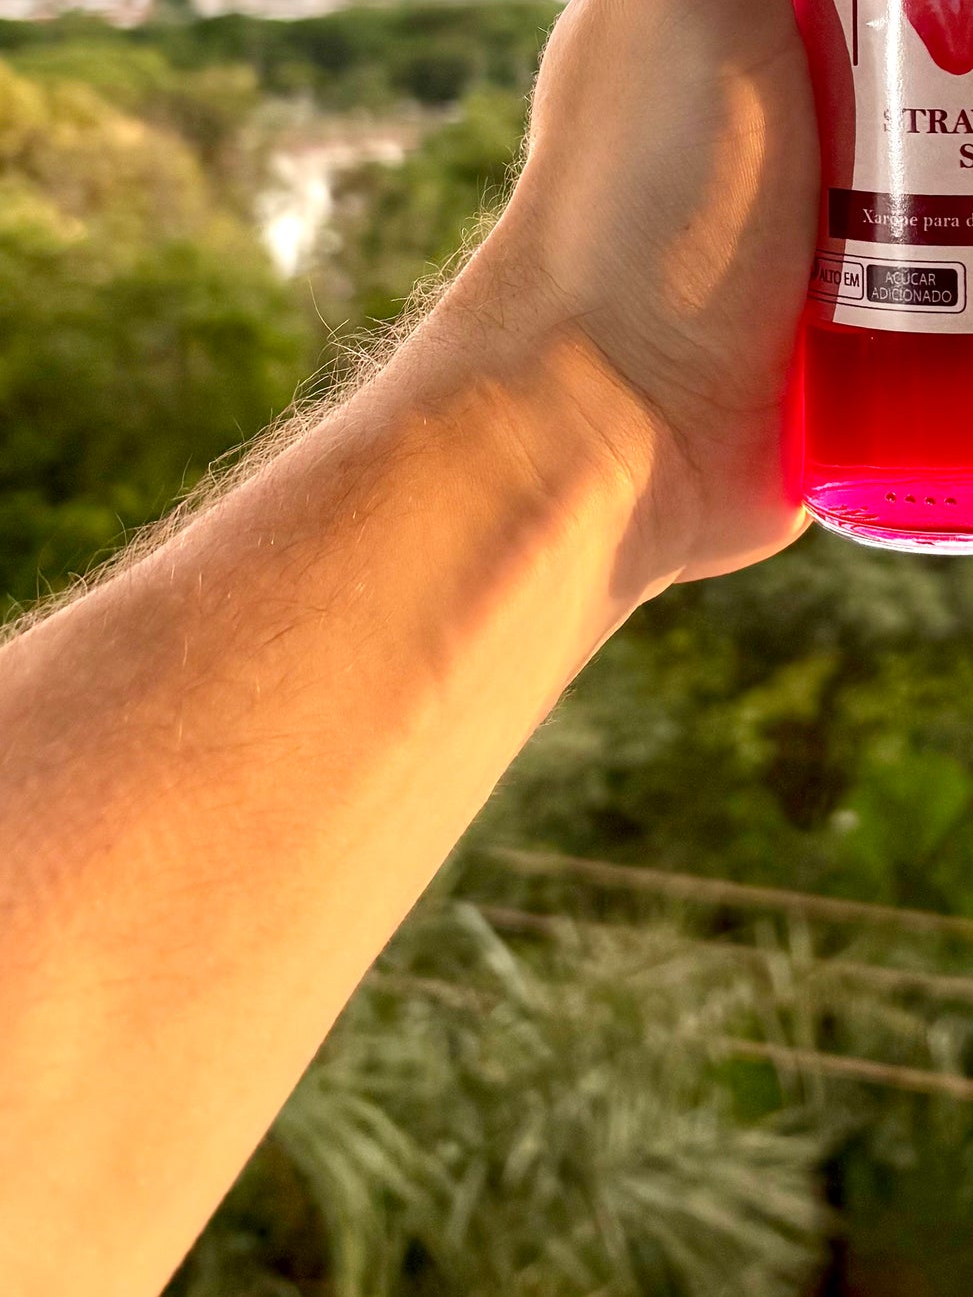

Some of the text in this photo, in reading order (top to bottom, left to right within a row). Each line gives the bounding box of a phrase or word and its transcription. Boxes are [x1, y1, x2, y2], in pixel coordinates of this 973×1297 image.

[923, 216, 960, 232] para
[820, 267, 860, 288] ALTO EM
[871, 286, 952, 303] ADICIONADO
